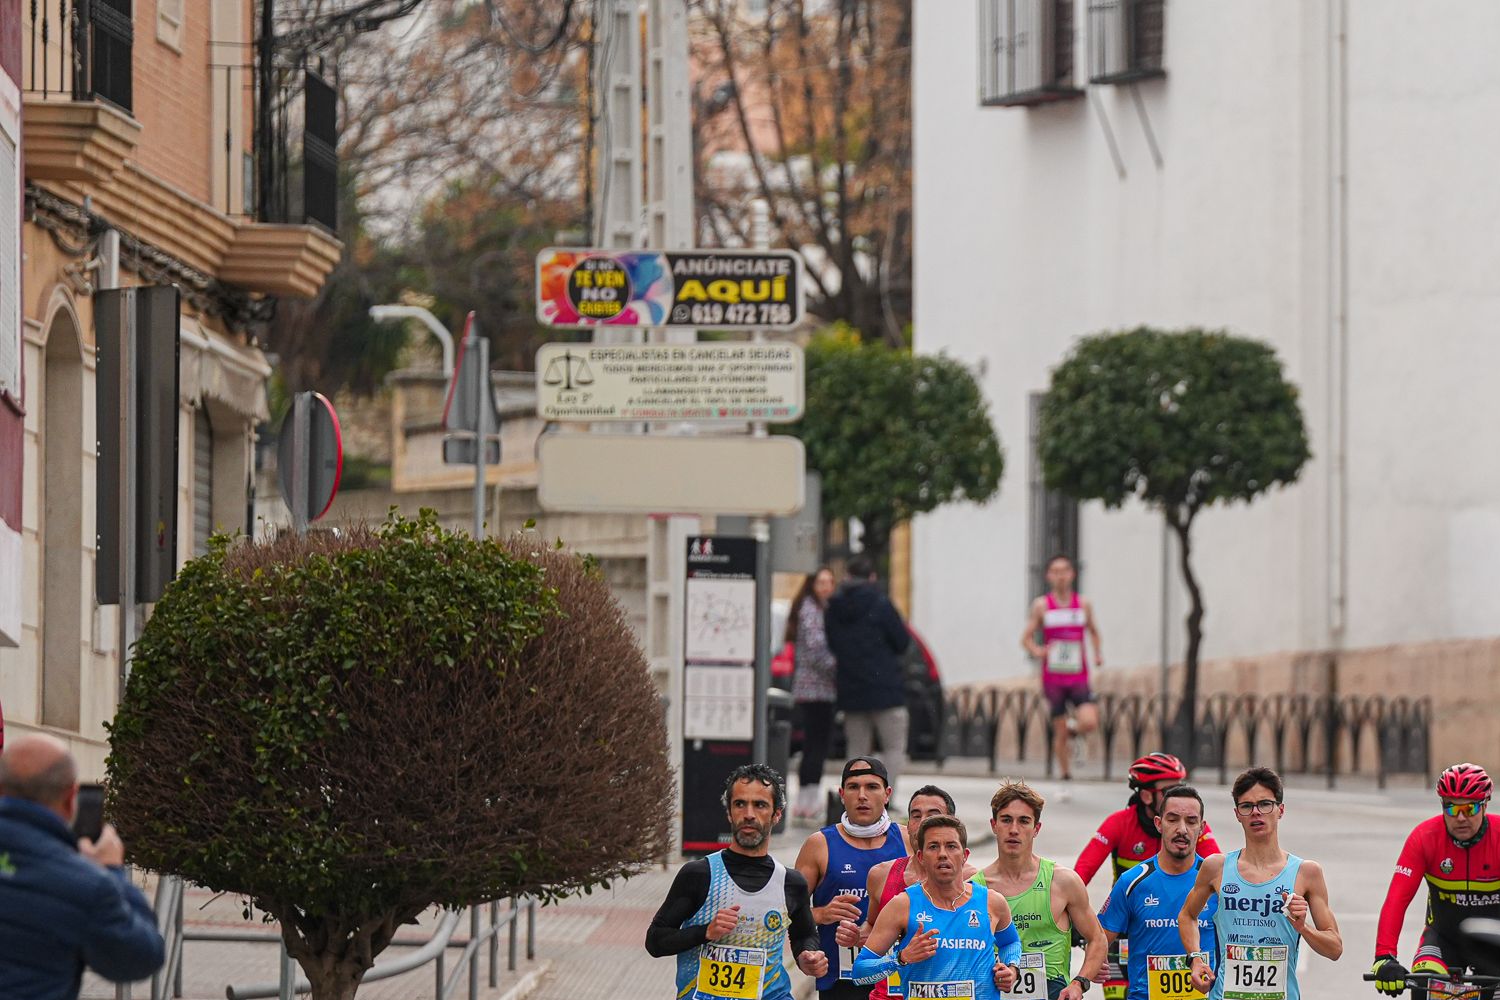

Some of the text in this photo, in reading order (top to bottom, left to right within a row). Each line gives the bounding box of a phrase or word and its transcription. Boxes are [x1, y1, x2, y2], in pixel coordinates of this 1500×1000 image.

[673, 257, 790, 275] ANÚNCIATE
[595, 271, 625, 287] VEN
[581, 288, 617, 301] NO
[677, 275, 786, 304] AQUÍ
[725, 304, 756, 324] 472
[1224, 894, 1285, 917] nerja
[1233, 917, 1276, 928] ATLETISMO
[709, 963, 746, 989] 334
[1233, 965, 1277, 986] 1542
